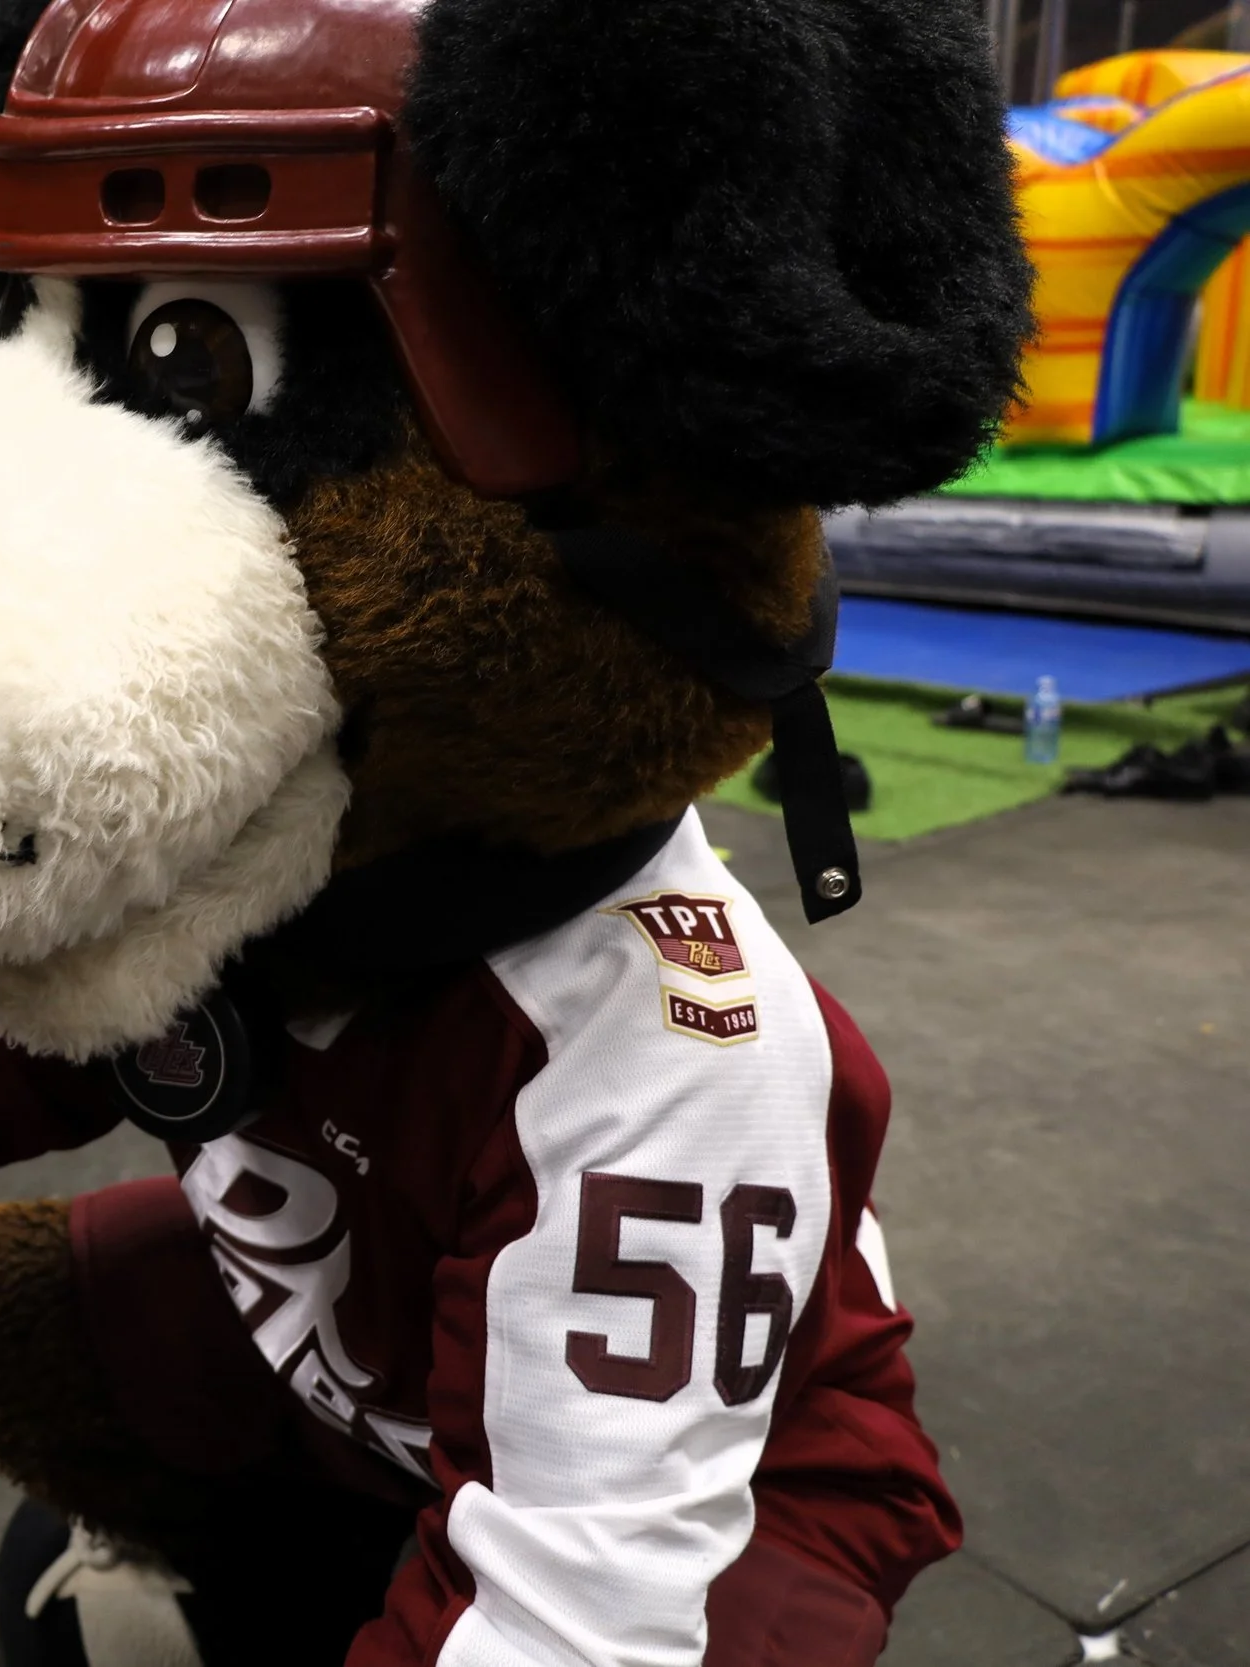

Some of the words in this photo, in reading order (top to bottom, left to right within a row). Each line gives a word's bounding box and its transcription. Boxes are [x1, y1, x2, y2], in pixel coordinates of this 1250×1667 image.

[640, 905, 724, 940] TPT
[681, 939, 722, 971] Petes
[674, 1002, 715, 1030] EST.
[565, 1171, 797, 1407] 56
